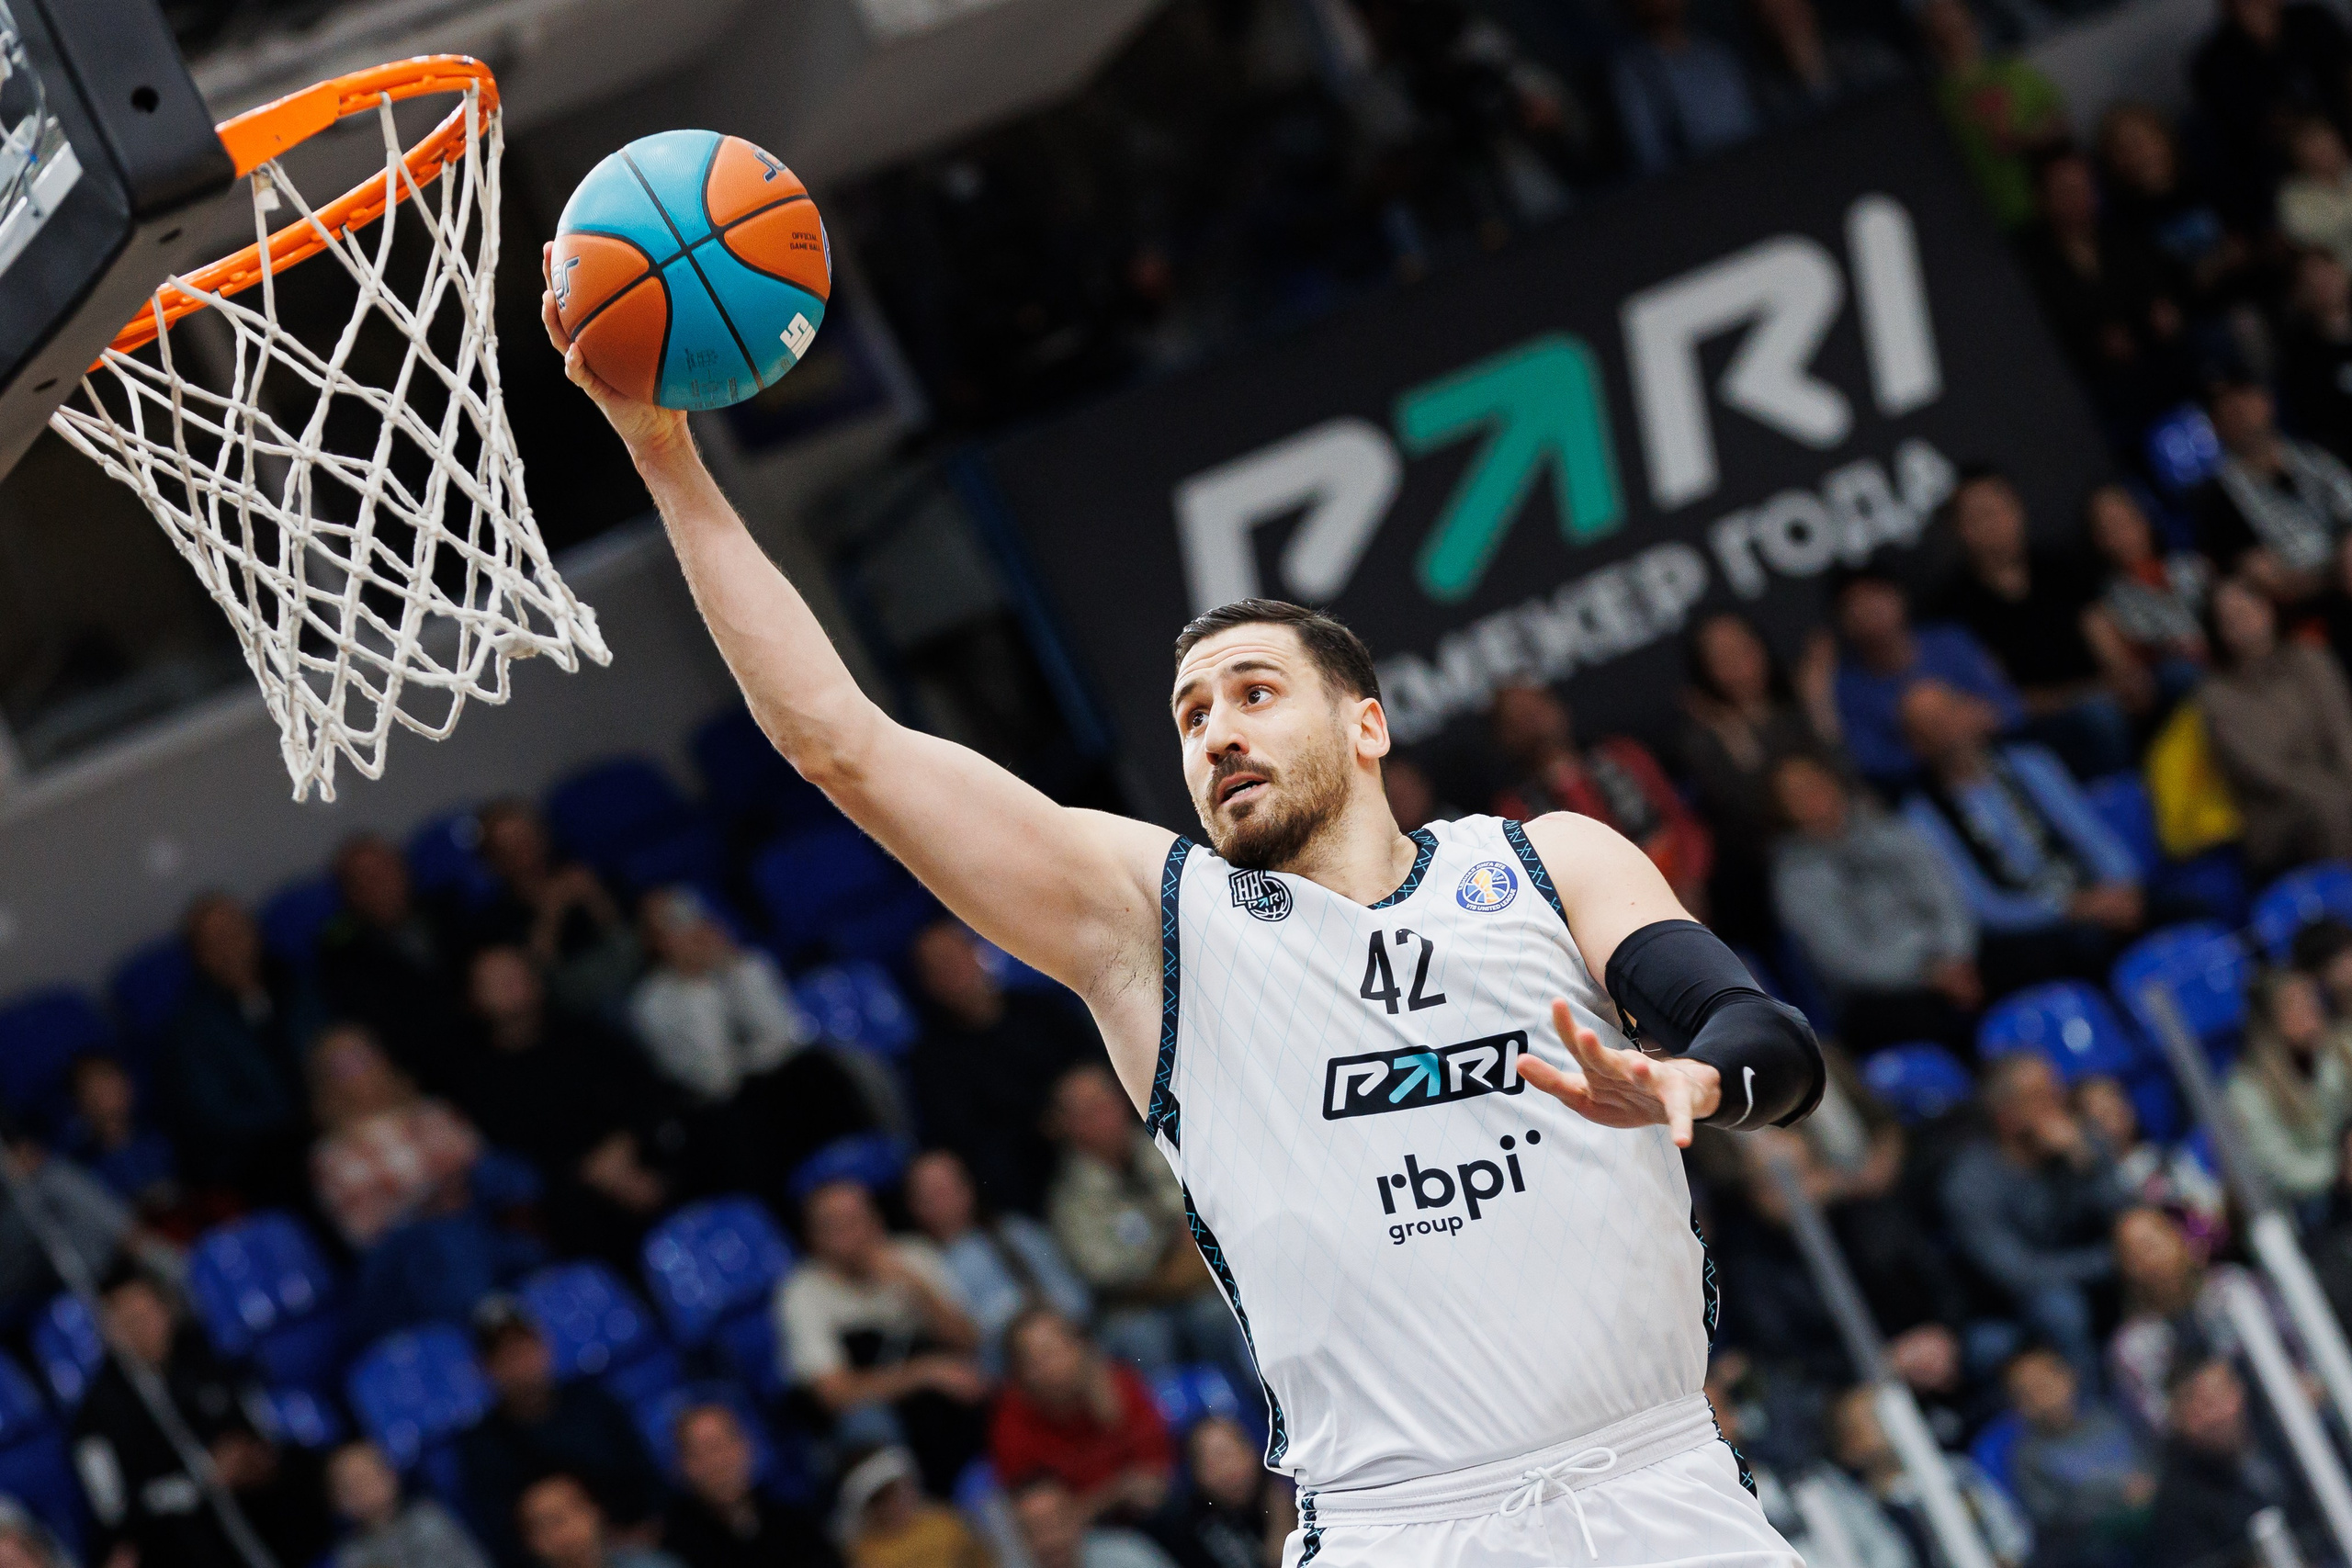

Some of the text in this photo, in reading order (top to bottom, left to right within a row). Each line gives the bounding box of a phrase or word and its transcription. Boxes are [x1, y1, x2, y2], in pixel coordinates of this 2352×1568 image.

[1172, 192, 1943, 621] PARI
[1360, 928, 1447, 1015] 42
[1331, 1039, 1520, 1111] PARI
[1388, 1214, 1464, 1246] group
